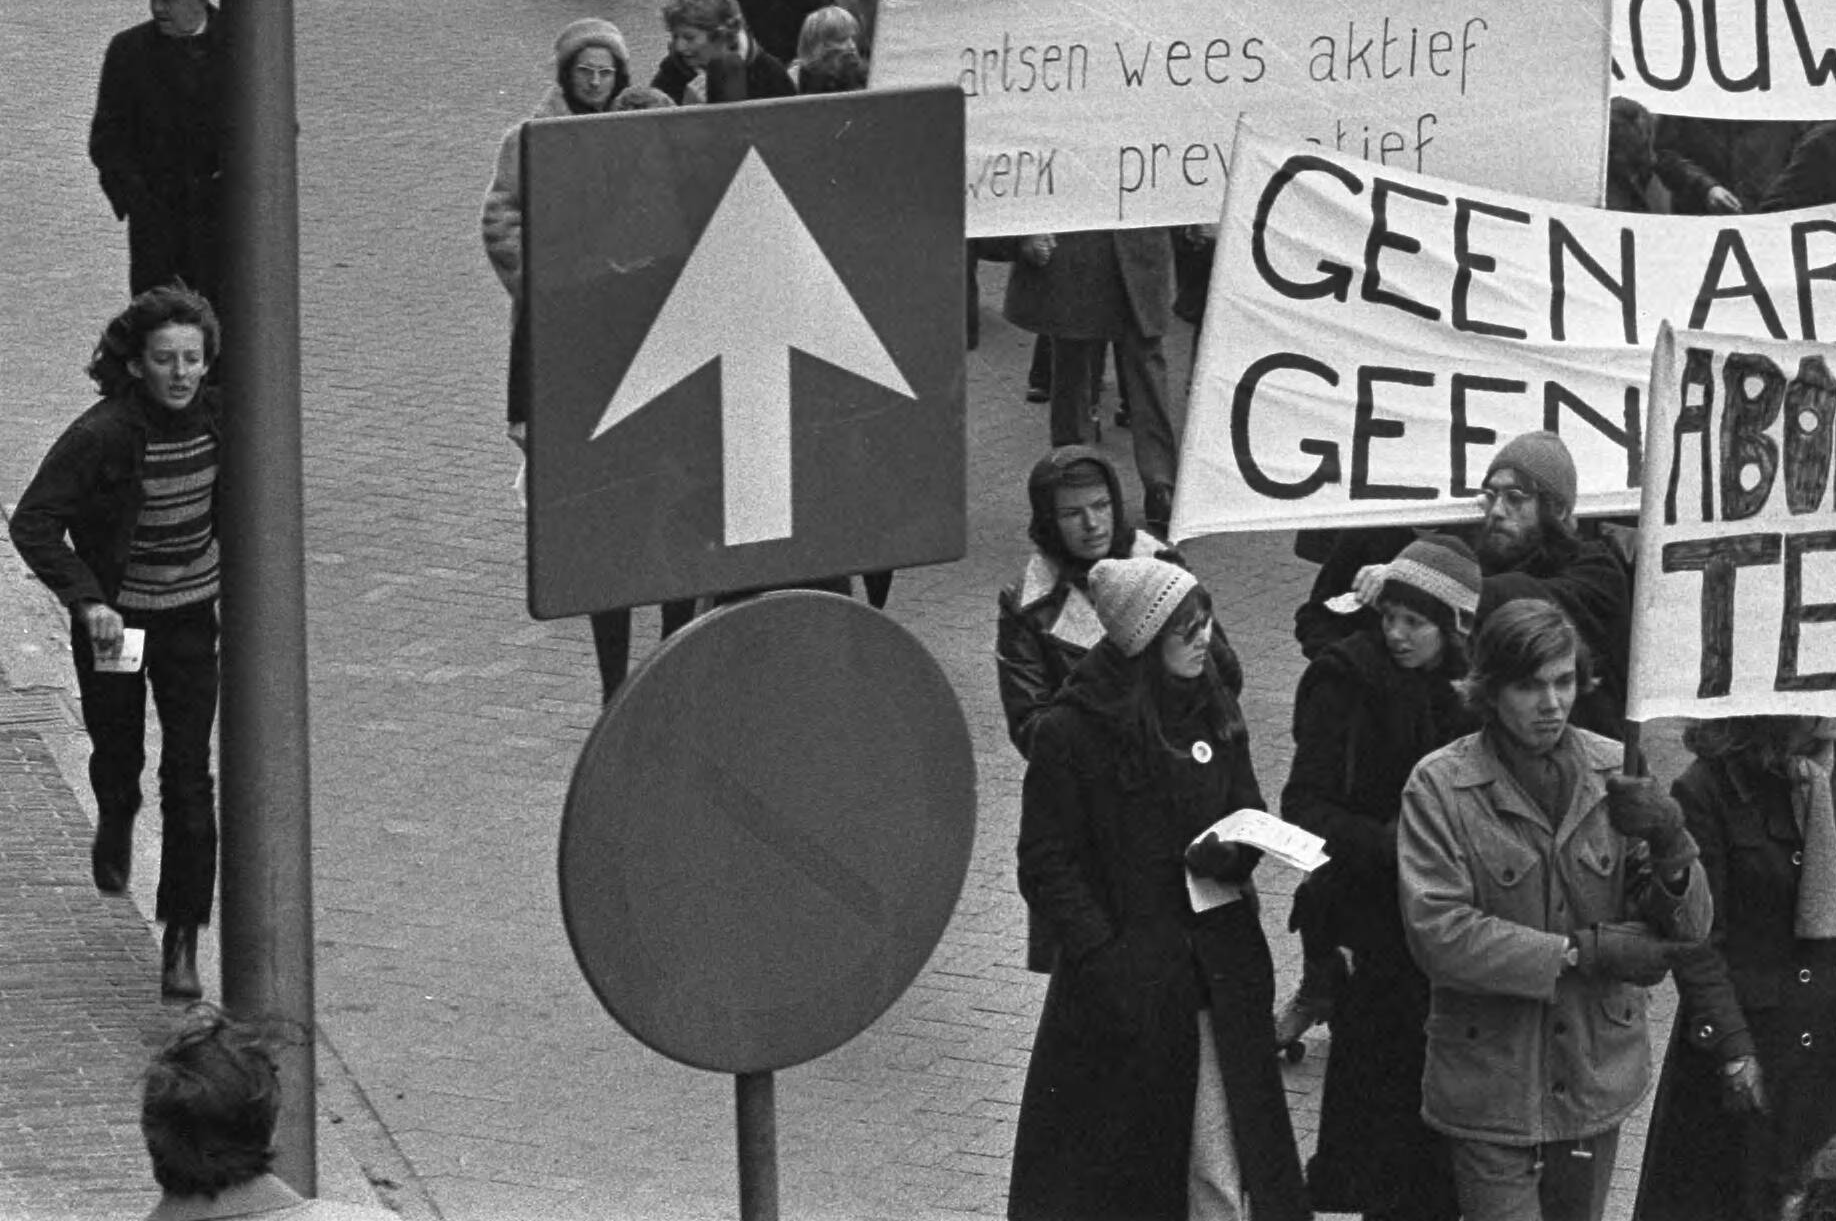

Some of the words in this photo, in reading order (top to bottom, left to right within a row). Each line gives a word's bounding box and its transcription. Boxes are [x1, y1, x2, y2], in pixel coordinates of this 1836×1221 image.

[957, 30, 1089, 98] artsen
[1115, 36, 1266, 87] wees
[1309, 16, 1489, 96] aktief
[1251, 154, 1640, 344] GEEN
[1229, 351, 1643, 500] GEEN
